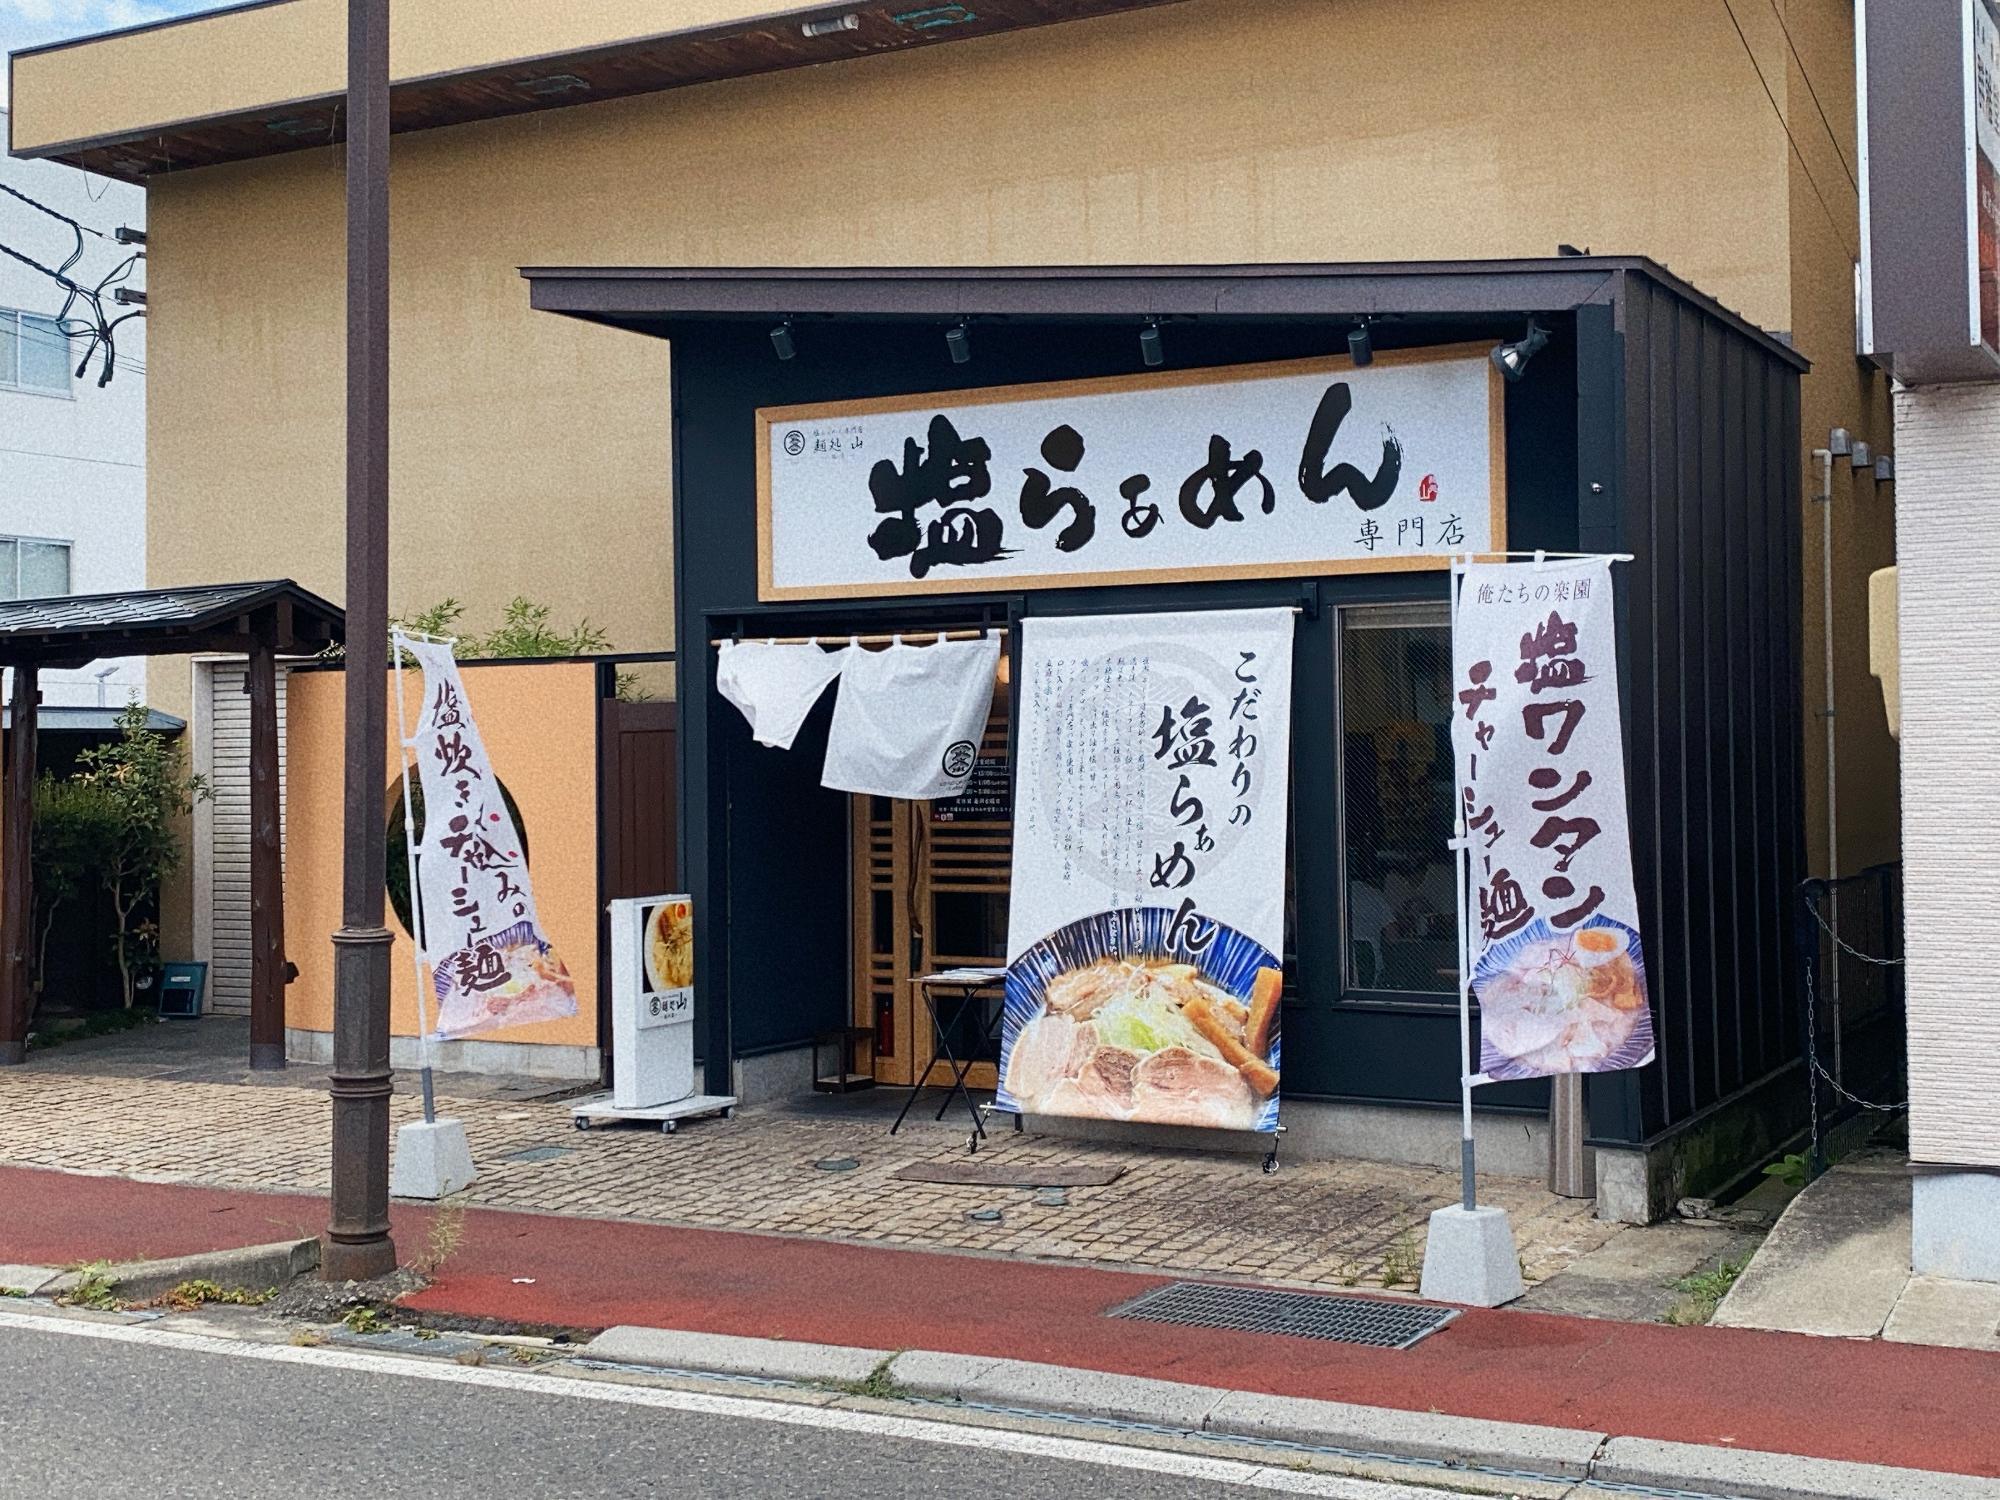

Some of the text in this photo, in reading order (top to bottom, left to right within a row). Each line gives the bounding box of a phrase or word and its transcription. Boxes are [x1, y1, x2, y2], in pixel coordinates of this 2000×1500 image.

[868, 382, 1405, 578] 塩らぁめん
[1352, 513, 1466, 548] 専門店
[1477, 577, 1592, 605] 俺たちの楽園
[1149, 695, 1219, 952] 塩らぁめん
[1227, 651, 1262, 827] こだわりの
[1459, 660, 1535, 953] チャーシュー麺
[1514, 610, 1605, 929] 塩ワンタン
